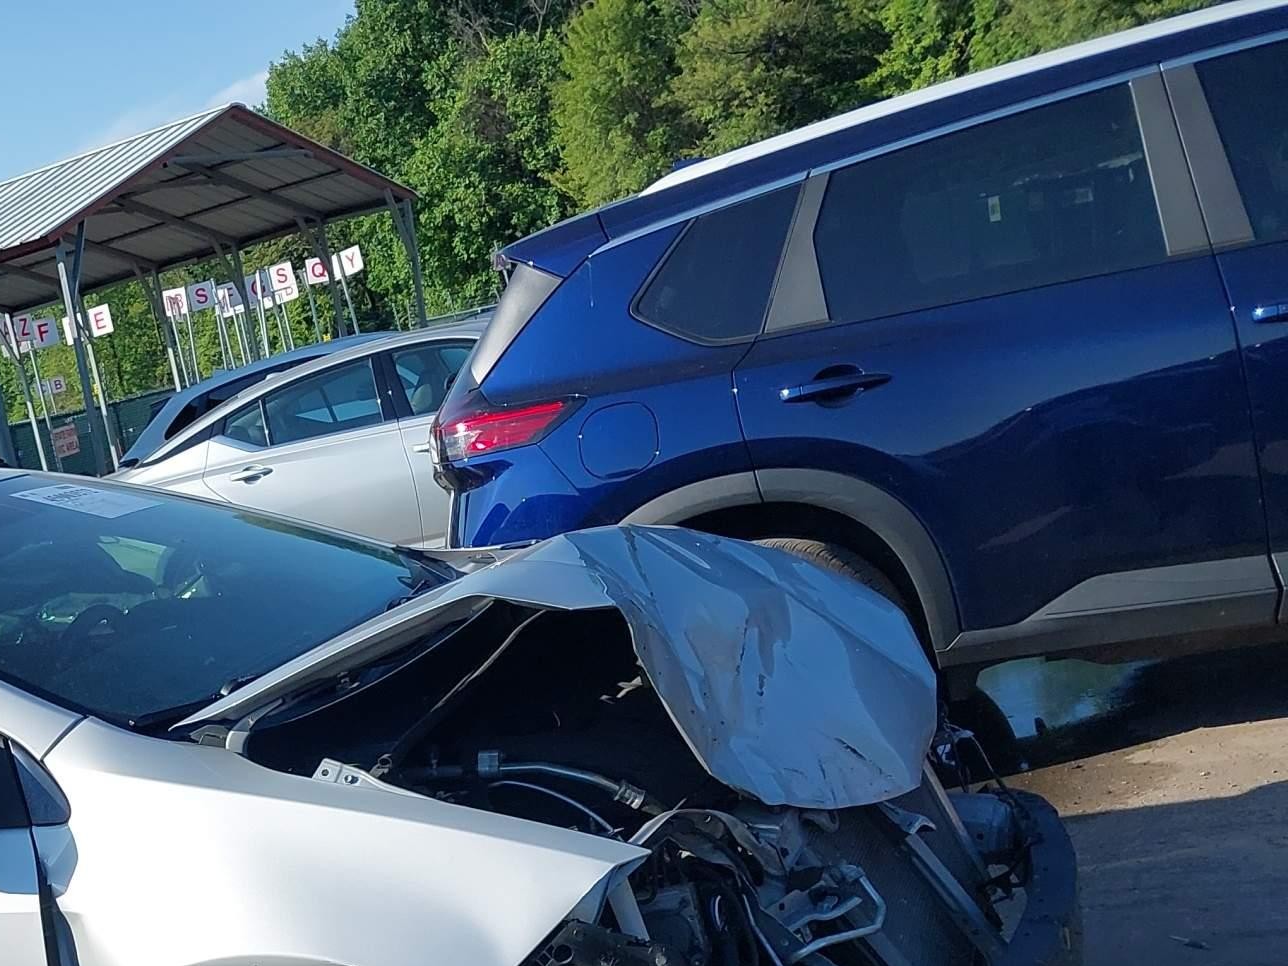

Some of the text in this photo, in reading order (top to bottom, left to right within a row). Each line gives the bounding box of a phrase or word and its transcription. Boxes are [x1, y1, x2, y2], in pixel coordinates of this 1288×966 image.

[345, 251, 357, 268] Y
[276, 267, 289, 284] S
[311, 262, 326, 278] Q
[194, 287, 209, 304] S
[18, 317, 31, 337] Z
[94, 311, 107, 330] E
[37, 322, 49, 342] F
[54, 379, 64, 391] B
